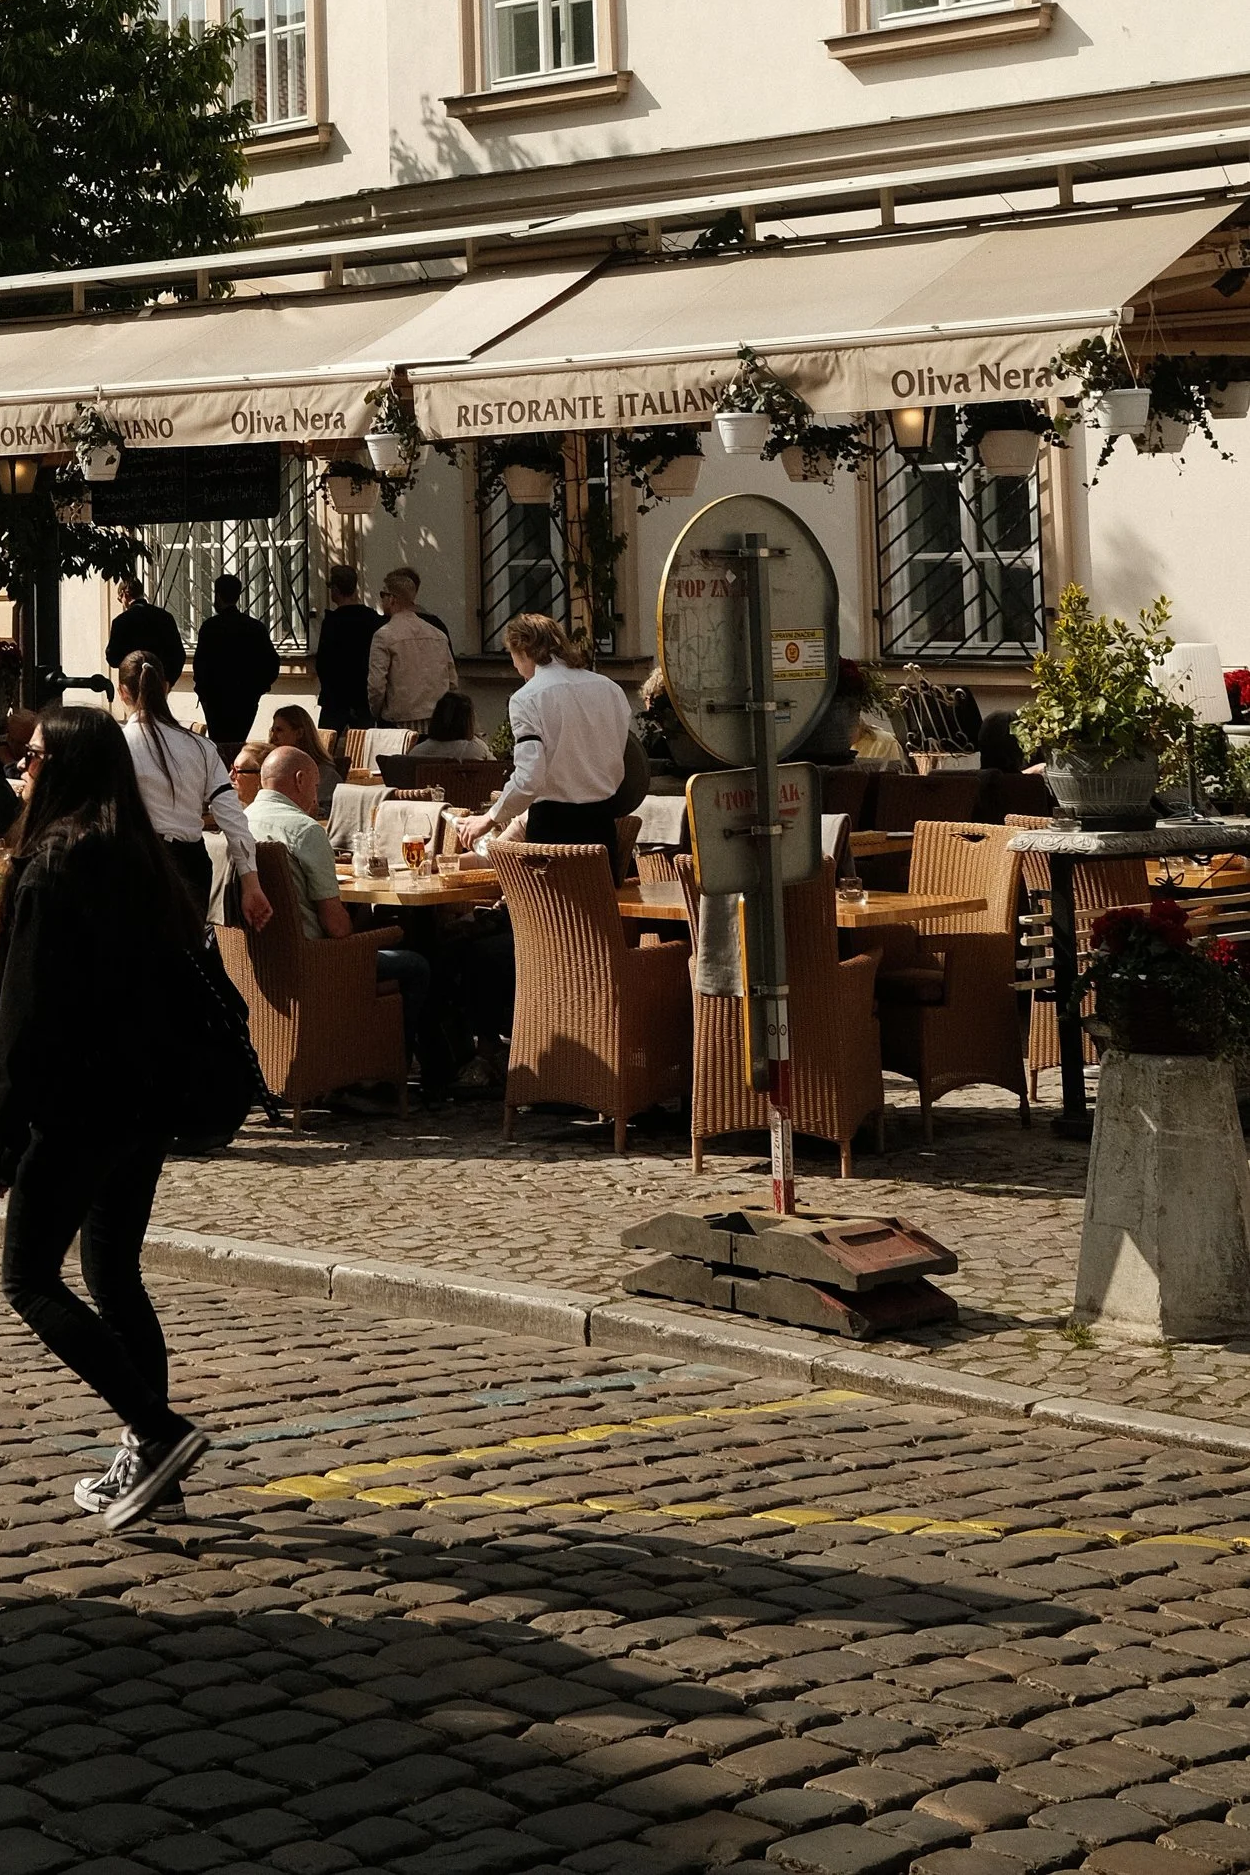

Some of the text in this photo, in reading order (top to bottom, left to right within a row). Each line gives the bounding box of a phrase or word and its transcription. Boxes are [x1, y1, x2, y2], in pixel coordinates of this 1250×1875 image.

[456, 362, 1054, 428] RISTORANTE ITALIAN Oliva Nera
[113, 417, 174, 439] LIANO
[231, 410, 287, 434] Oliva
[293, 407, 346, 432] Nera
[676, 578, 706, 598] TOP
